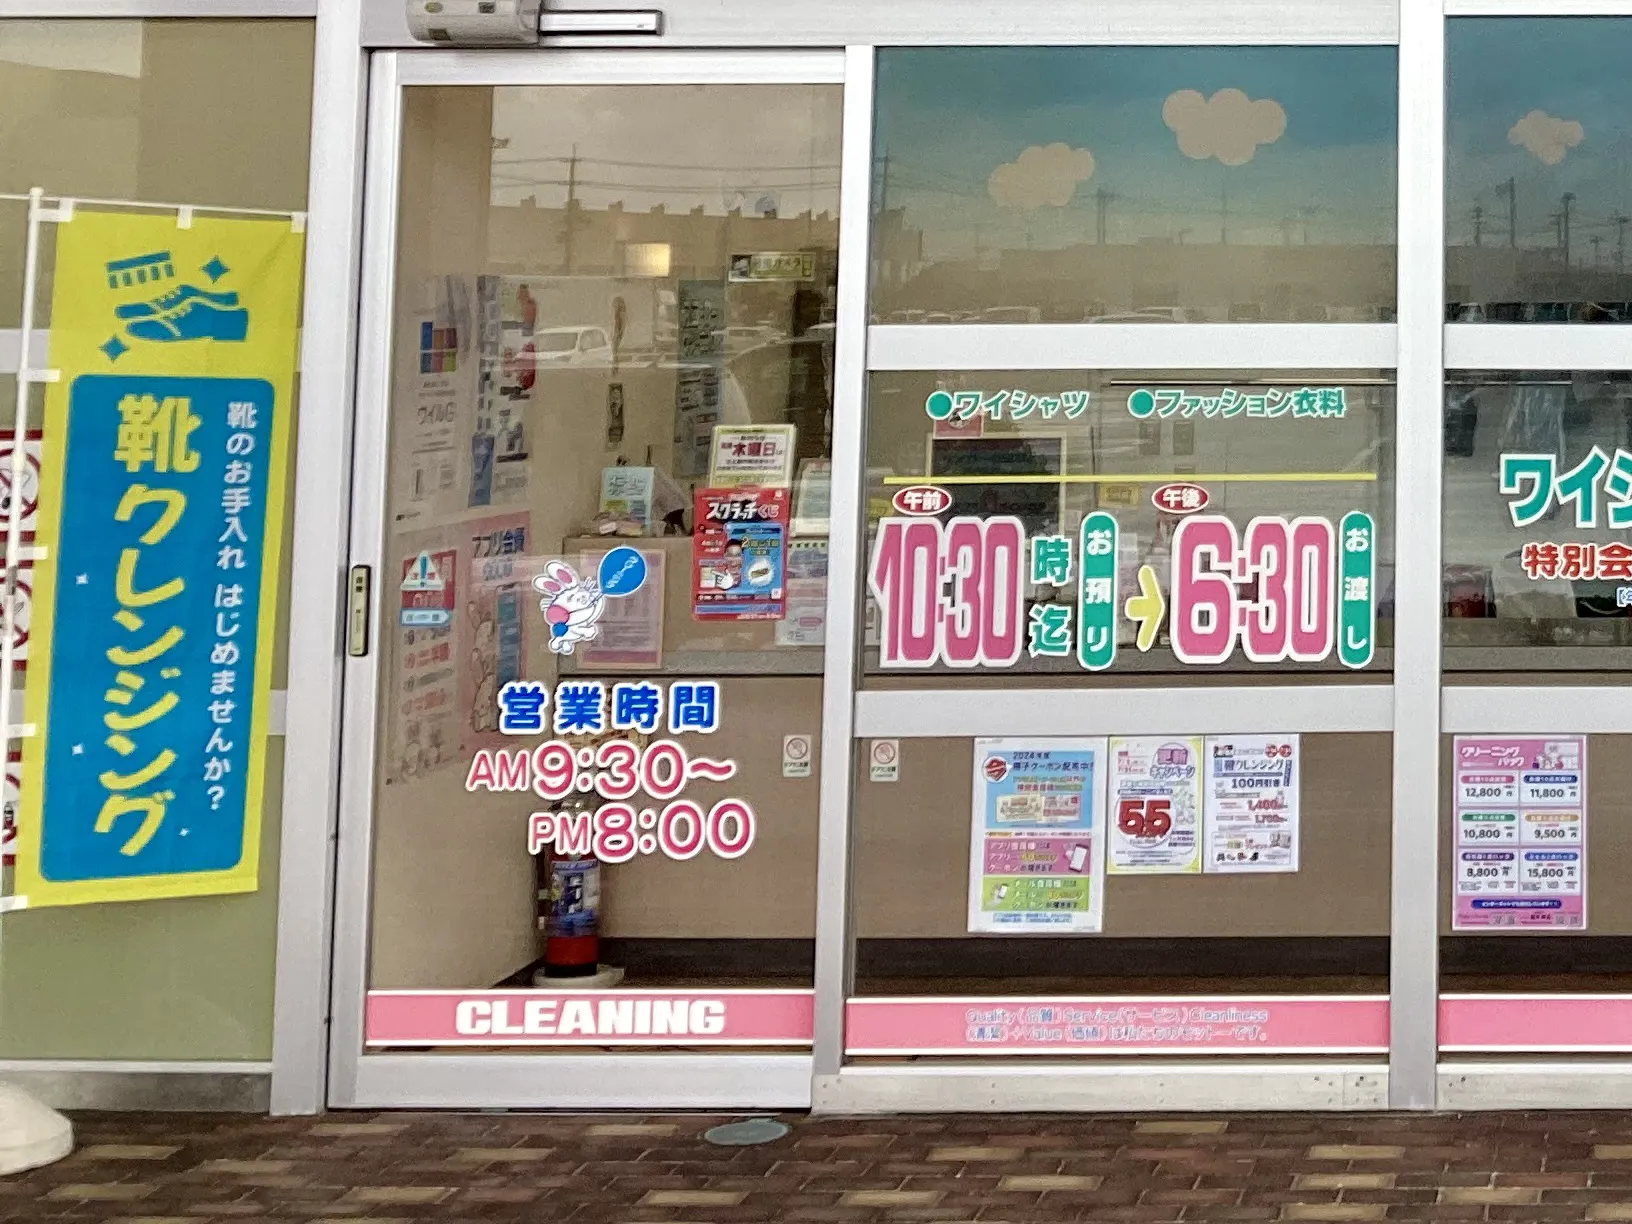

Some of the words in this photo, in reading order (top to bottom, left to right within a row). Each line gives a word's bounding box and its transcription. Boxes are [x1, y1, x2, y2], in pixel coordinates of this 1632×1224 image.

[953, 389, 1090, 420] ワイシャツ
[1154, 387, 1346, 419] ファッション衣料
[216, 401, 259, 570] 靴のお手入れ
[901, 489, 944, 512] 午前
[1163, 487, 1200, 510] 午後
[868, 516, 1025, 668] 10:30
[1028, 535, 1073, 658] 時迄
[1084, 527, 1113, 653] お預り
[1170, 515, 1335, 664] 6:30
[1344, 527, 1370, 650] お渡し
[94, 393, 203, 856] 靴クレンジング
[498, 681, 720, 734] 営業時間
[1465, 787, 1501, 798] 12,800
[1530, 788, 1564, 798] 11,800
[528, 798, 755, 862] PM8:00
[1464, 829, 1500, 839] 10,800
[1534, 829, 1565, 839] 9,500
[1467, 868, 1498, 878] 8,800
[455, 998, 726, 1035] CLEANING
